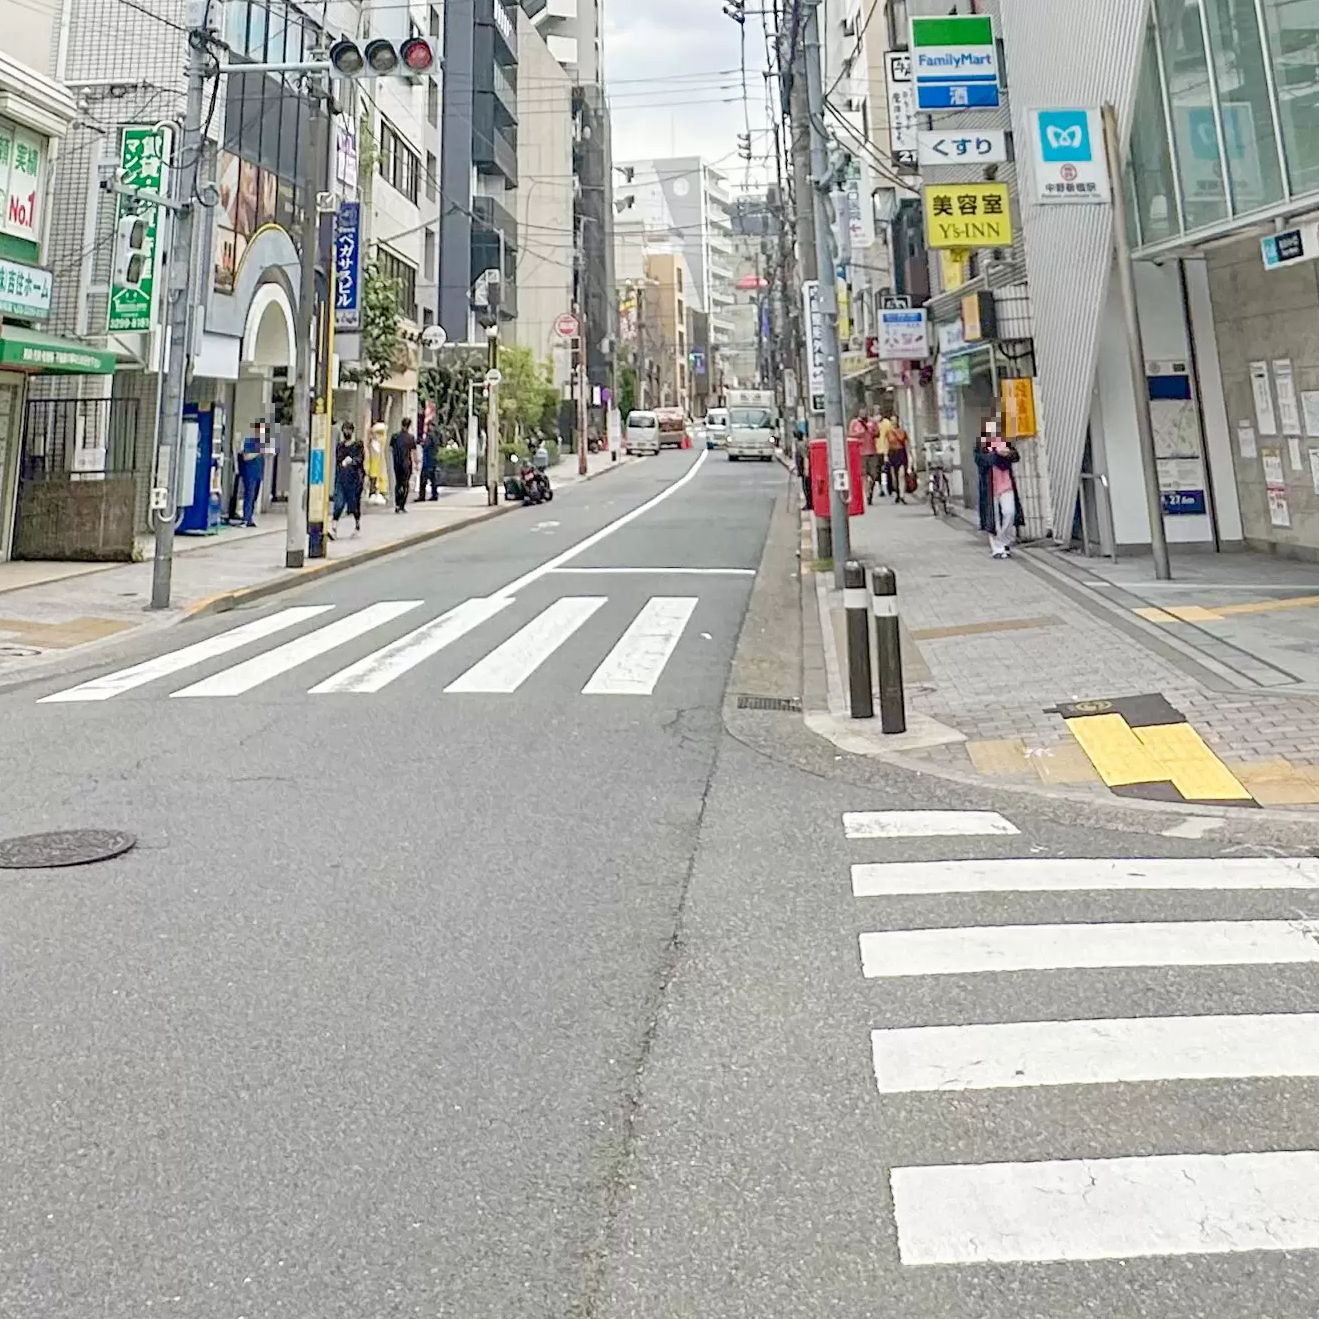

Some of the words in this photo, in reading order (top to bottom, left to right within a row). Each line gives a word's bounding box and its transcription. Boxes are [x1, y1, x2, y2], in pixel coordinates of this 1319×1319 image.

[918, 52, 992, 68] FamilyMart
[948, 86, 969, 106] 酒
[932, 138, 992, 156] くすり
[8, 190, 35, 229] No.1
[932, 194, 1003, 216] 美容室
[938, 221, 1000, 239] Y's-INN
[337, 233, 354, 307] ペガサスビル
